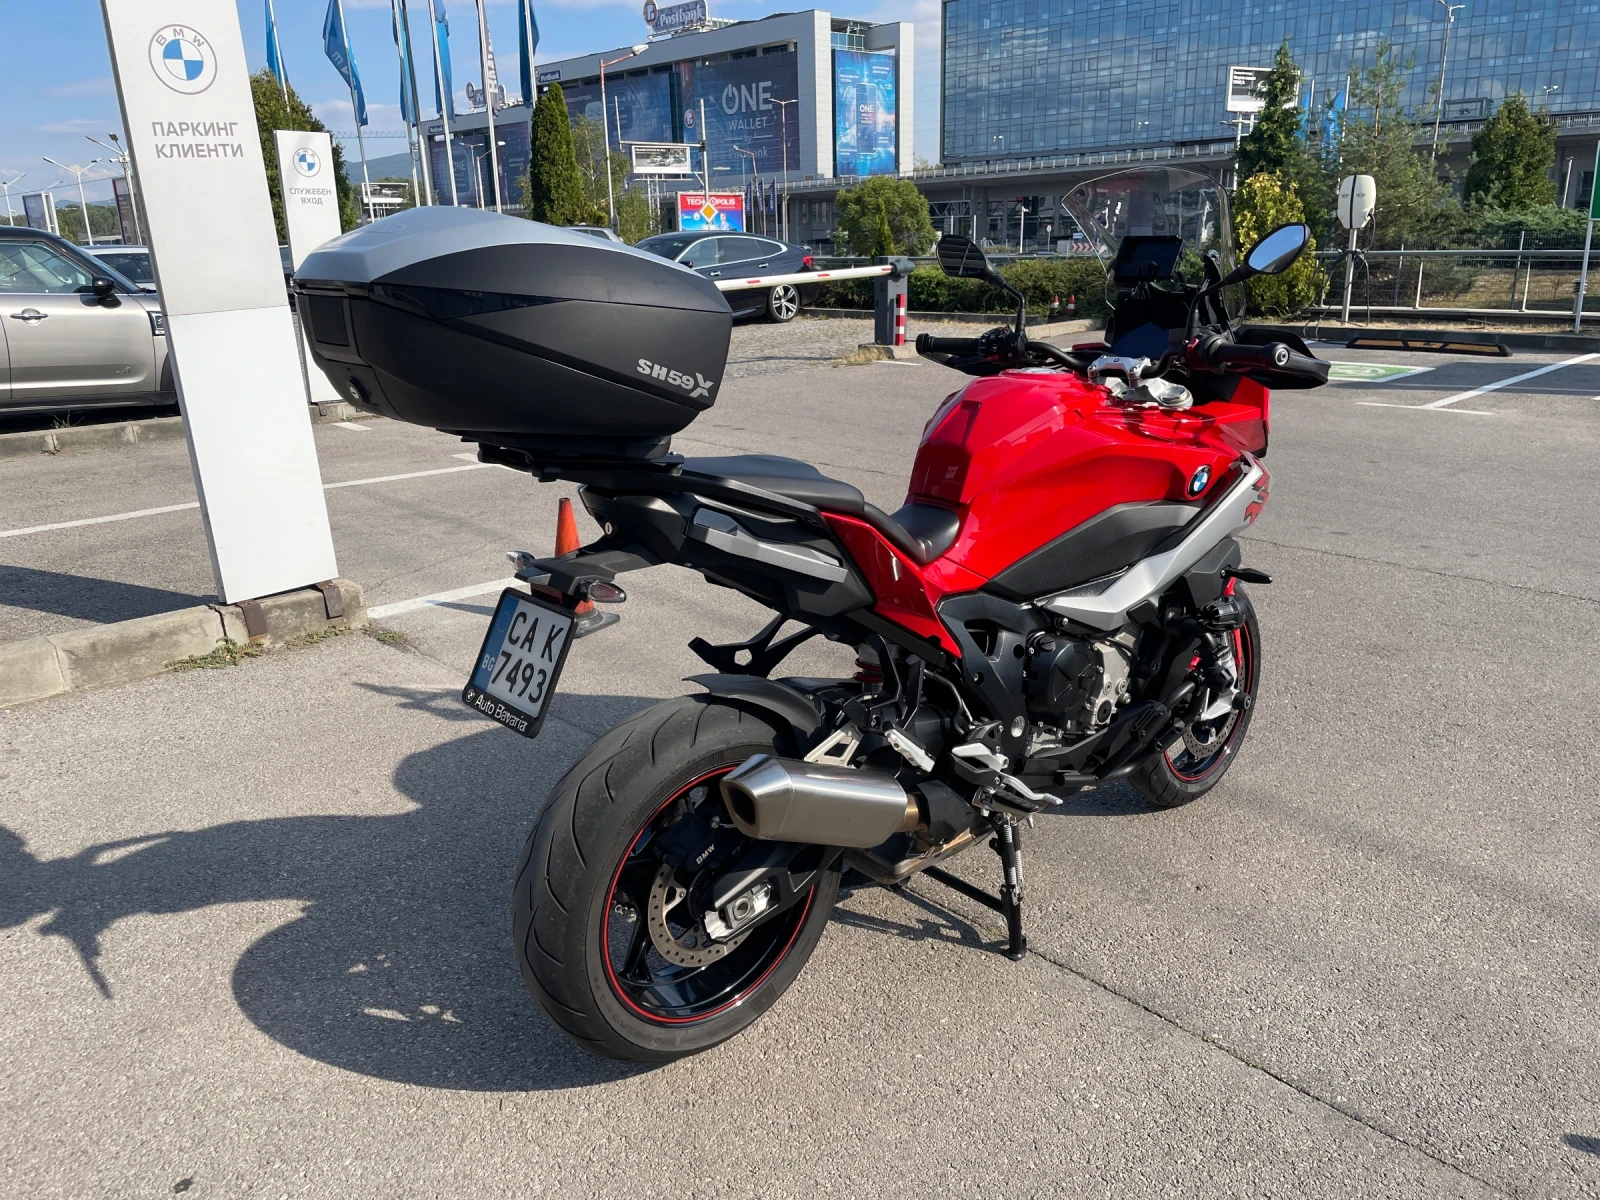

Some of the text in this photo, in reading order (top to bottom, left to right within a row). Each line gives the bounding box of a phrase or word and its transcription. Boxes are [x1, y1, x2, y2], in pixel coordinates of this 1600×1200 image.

[660, 4, 705, 27] Postbank
[155, 28, 205, 47] BMW
[721, 80, 773, 115] ONE
[859, 104, 874, 113] ONE
[151, 121, 238, 137] ПАРКИНГ
[728, 116, 768, 131] WALLET
[744, 133, 753, 144] by
[155, 143, 244, 158] КЛИЕНТИ
[289, 187, 332, 195] СЛУЖЕБЕН
[300, 197, 323, 205] ВХОД
[686, 197, 736, 206] TECHOPOLIS
[508, 611, 564, 662] CA K
[481, 653, 496, 672] BG
[491, 651, 547, 704] 7493
[474, 694, 528, 732] Auto Bavaria
[696, 843, 715, 865] BMW
